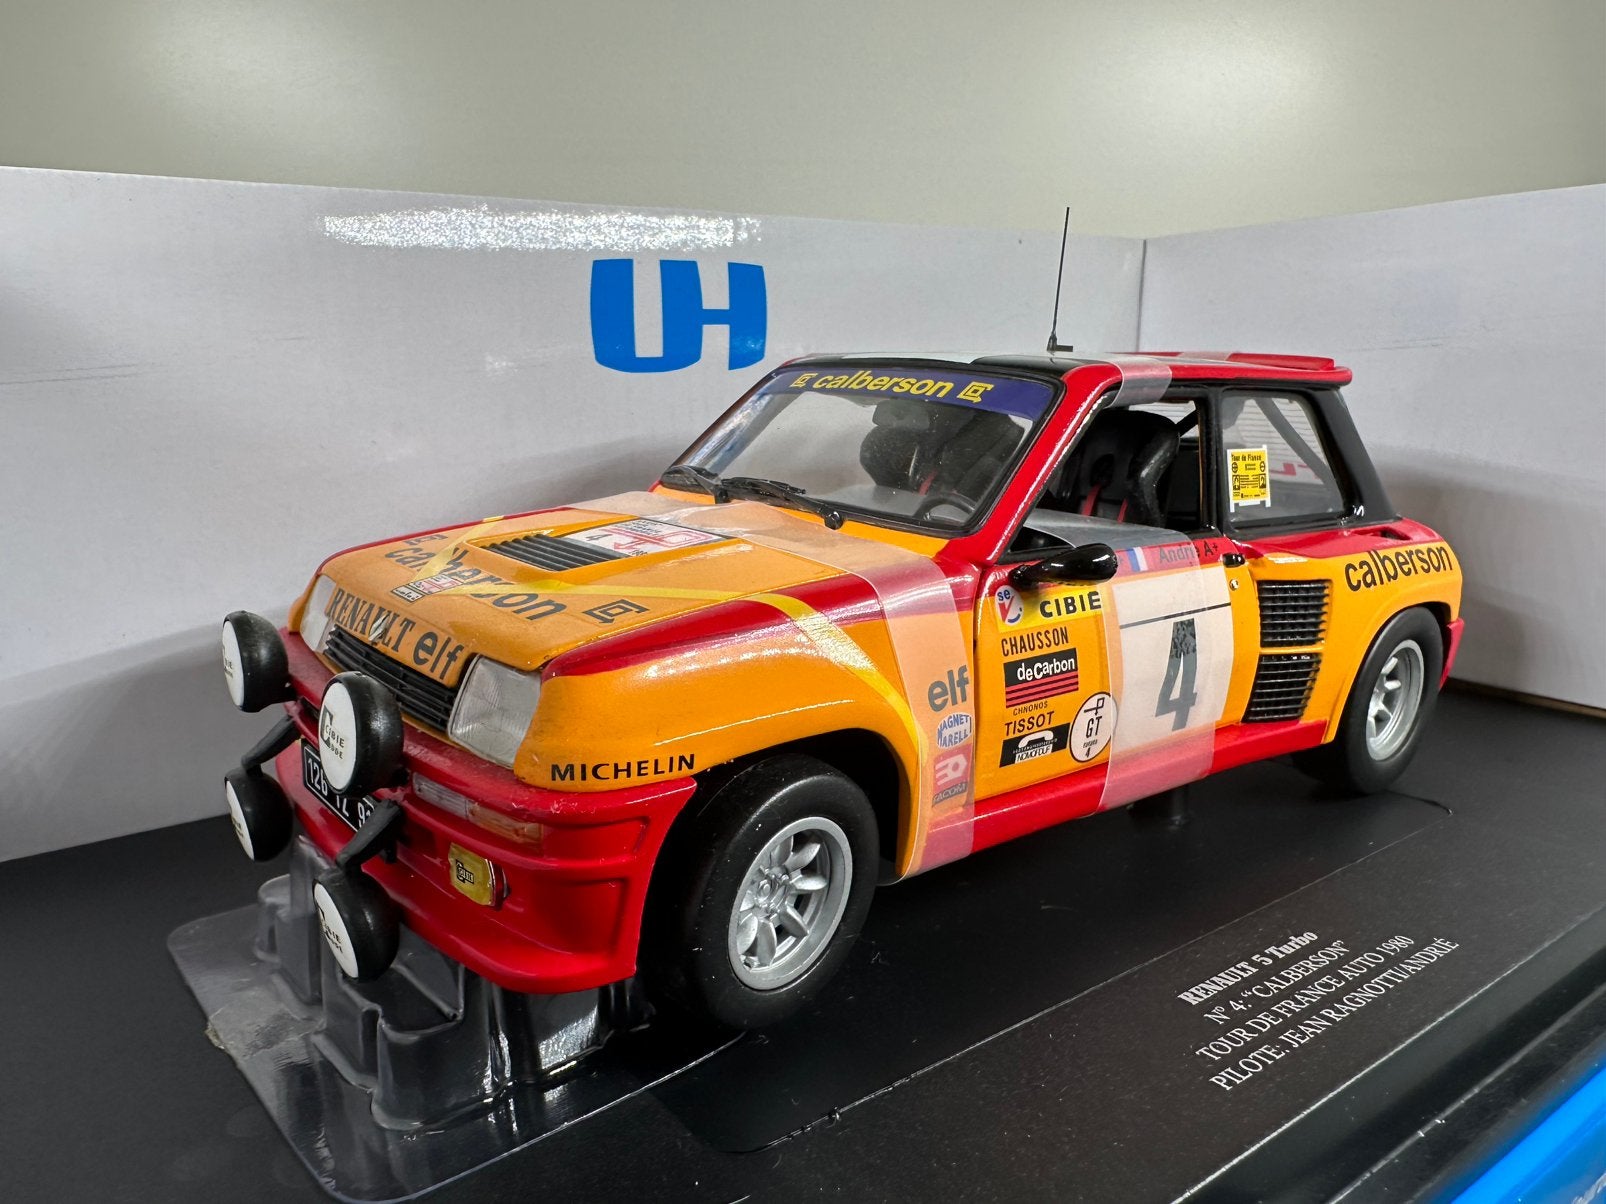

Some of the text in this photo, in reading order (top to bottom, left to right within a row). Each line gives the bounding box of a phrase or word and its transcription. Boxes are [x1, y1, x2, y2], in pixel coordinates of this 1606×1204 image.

[812, 370, 955, 398] calberson
[1345, 546, 1453, 592] calberson
[1039, 590, 1102, 618] CIBIE
[413, 631, 465, 680] elf
[1001, 626, 1069, 657] CHAUSSON
[928, 664, 970, 712] elf
[1155, 617, 1198, 732] 4
[1004, 711, 1055, 737] TISSOT
[1086, 716, 1103, 738] GT
[551, 753, 695, 782] MICHELIN
[1177, 931, 1318, 1006] RENAULT 5 Turbo
[1195, 935, 1415, 1062] TOUR DE FRANCE AUTO 1980
[1209, 1044, 1290, 1091] PILOTE:
[1283, 1008, 1333, 1048] JEAN
